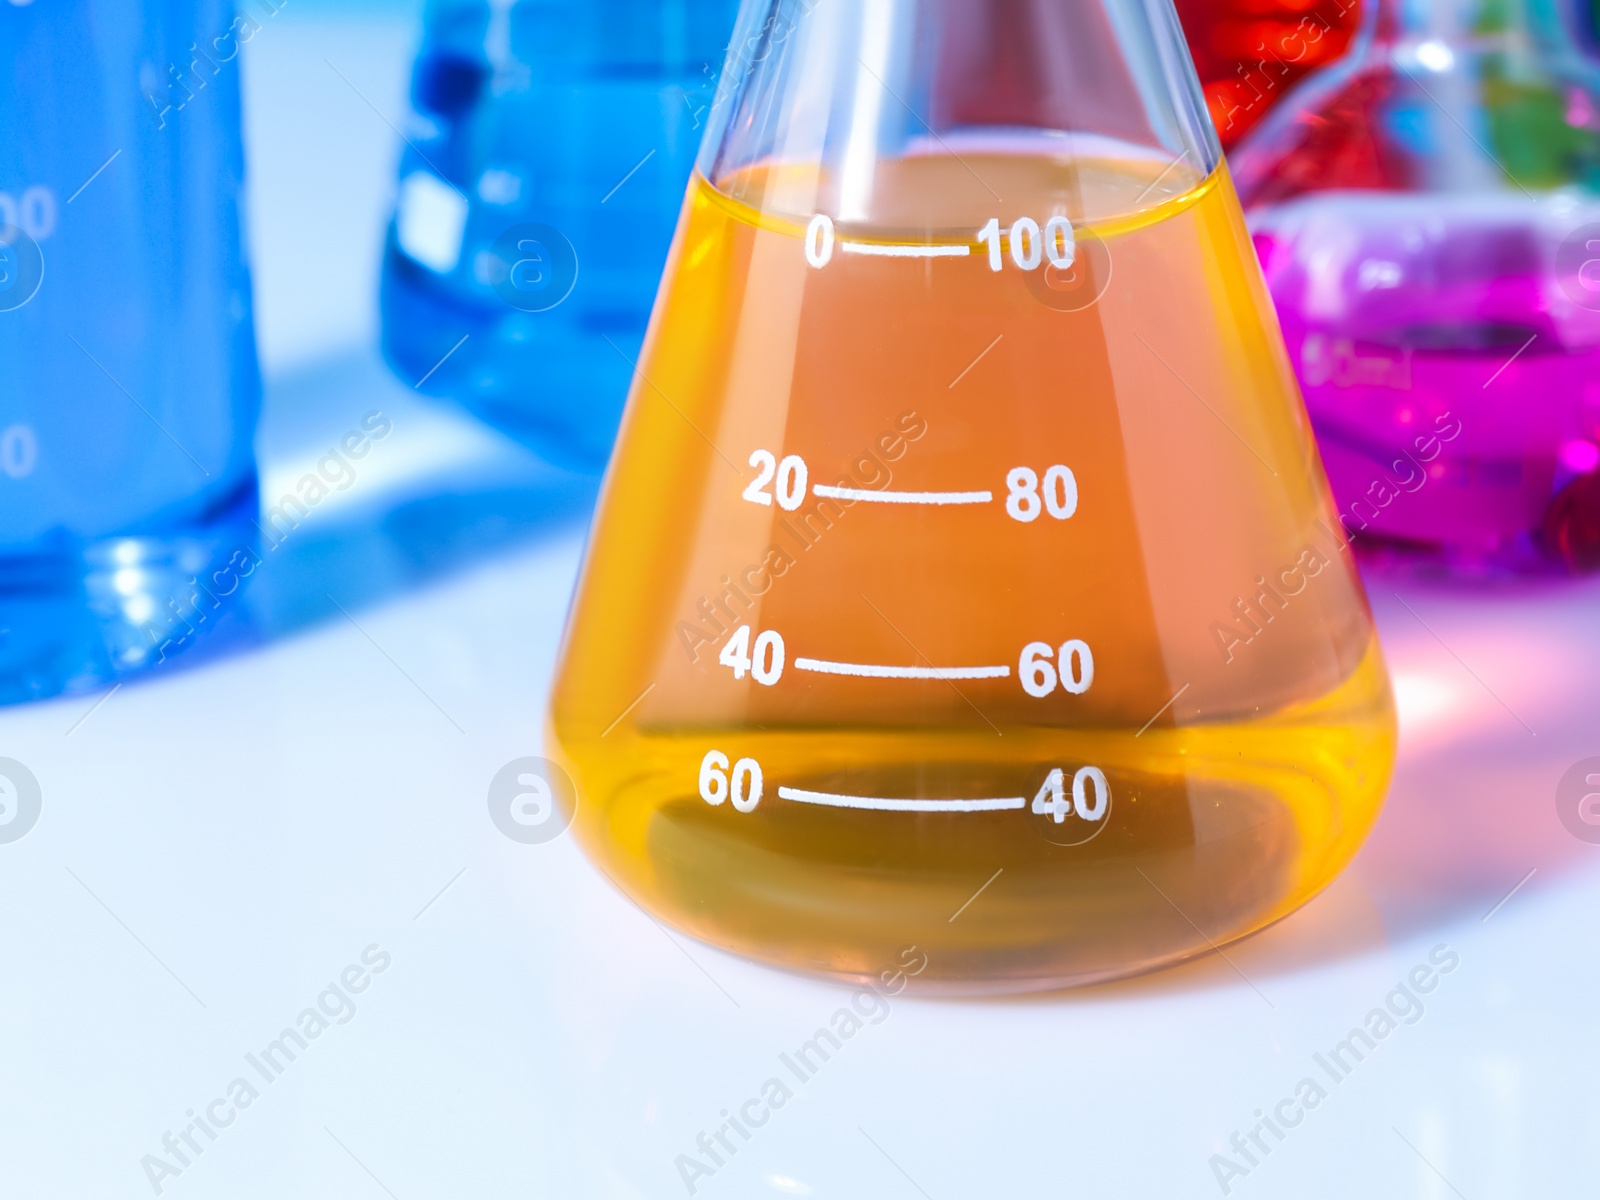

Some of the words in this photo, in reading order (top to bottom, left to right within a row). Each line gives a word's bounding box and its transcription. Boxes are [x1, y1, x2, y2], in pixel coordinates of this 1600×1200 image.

[805, 214, 835, 269] 0
[978, 216, 1075, 271] 100
[742, 449, 808, 511] 20
[1006, 464, 1078, 522] 80
[719, 625, 785, 686] 40
[1018, 639, 1094, 698] 60
[699, 750, 763, 813] 60
[1031, 765, 1107, 823] 40
